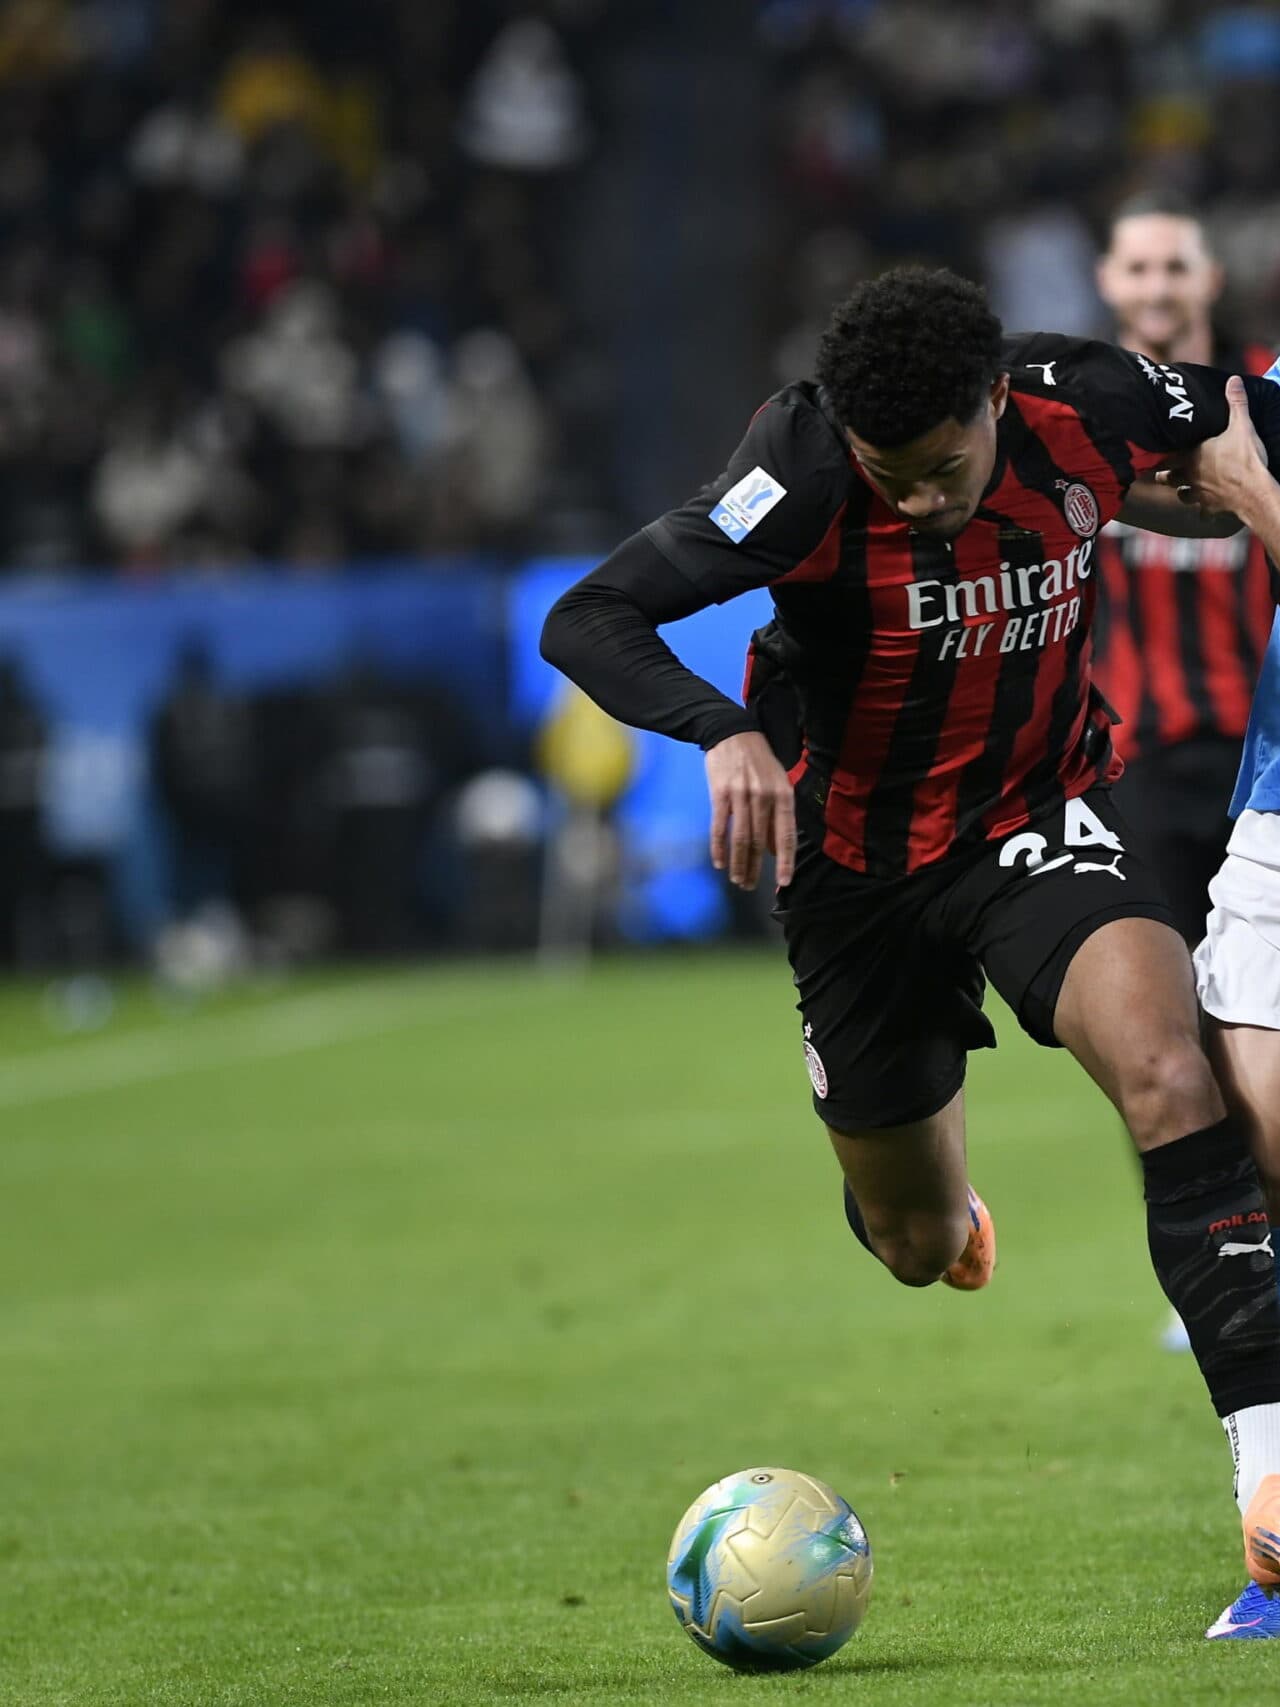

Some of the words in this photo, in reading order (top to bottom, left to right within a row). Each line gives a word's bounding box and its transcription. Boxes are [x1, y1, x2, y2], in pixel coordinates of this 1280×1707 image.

[905, 537, 1095, 629] Emirate
[938, 622, 995, 661] FLY
[999, 797, 1125, 876] 24
